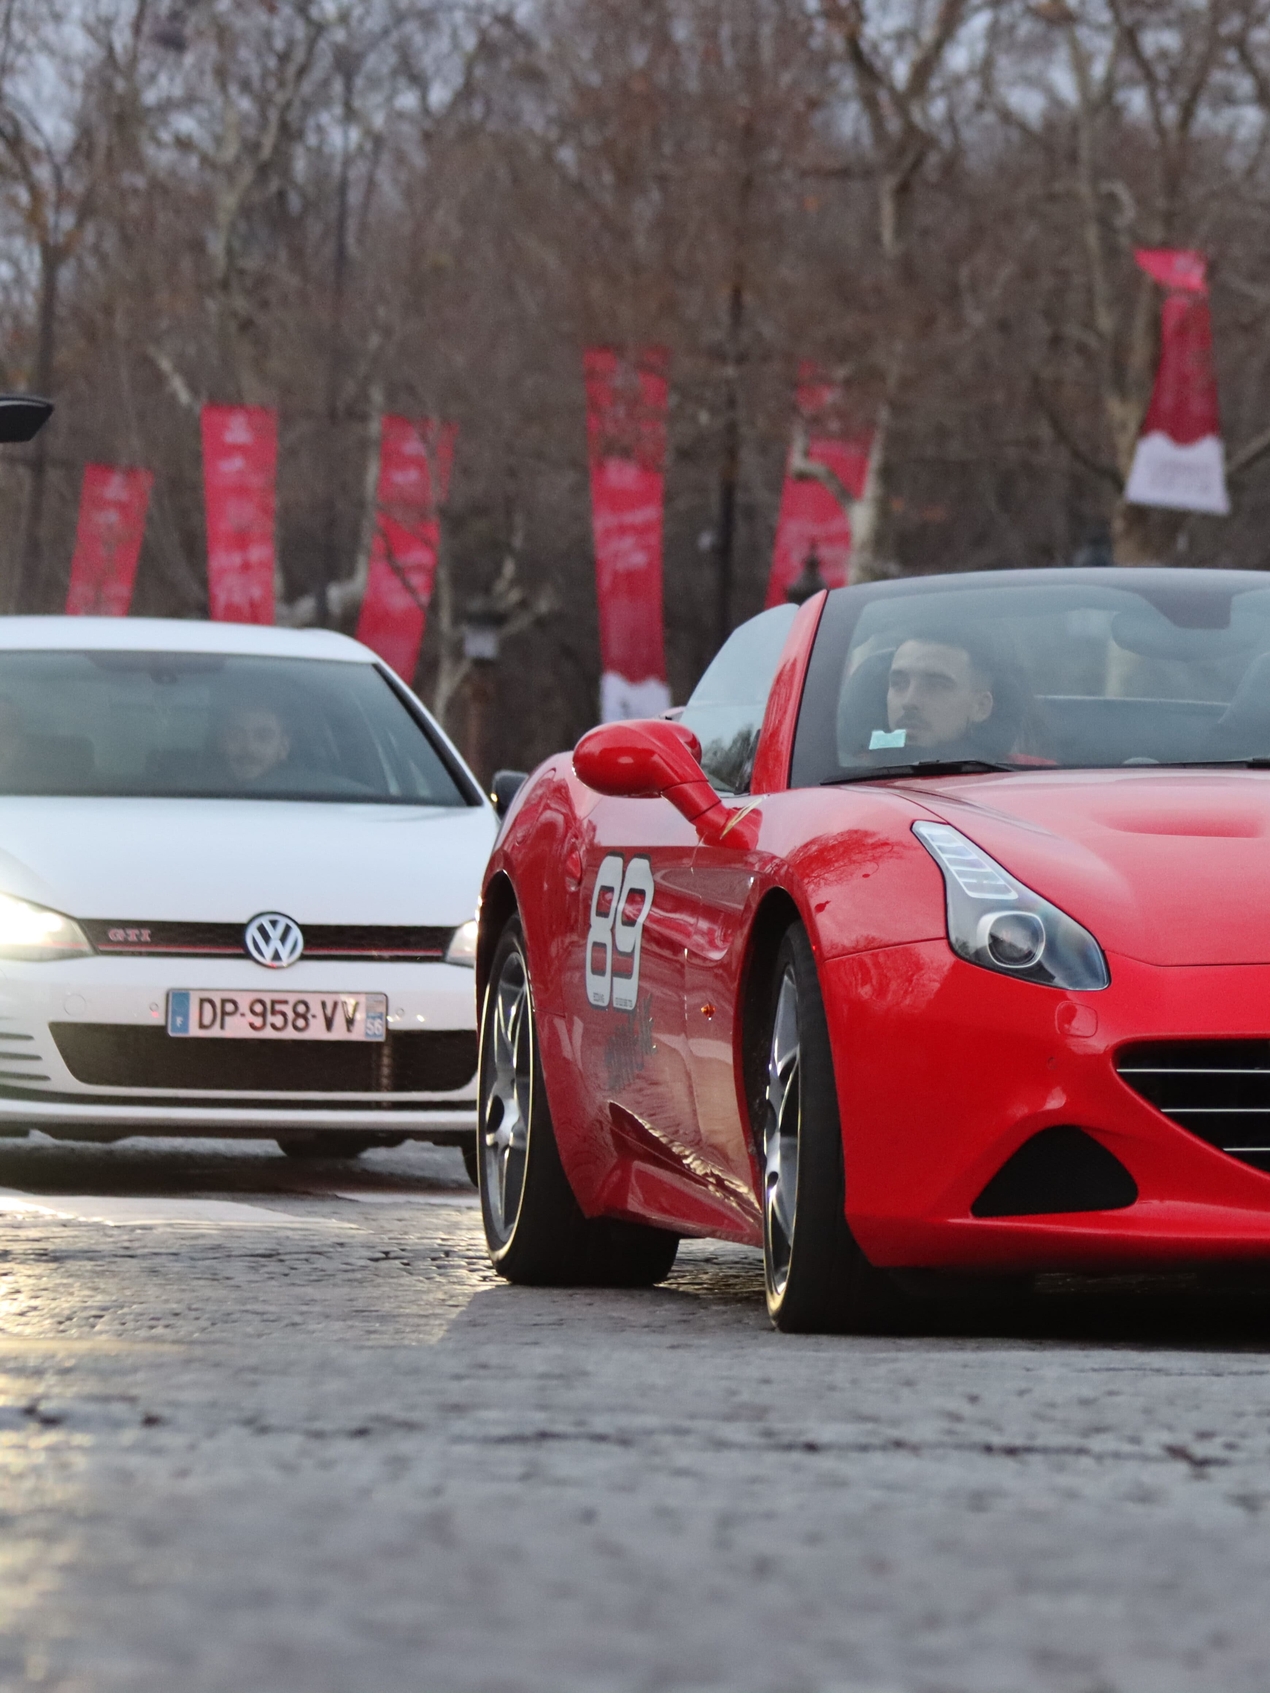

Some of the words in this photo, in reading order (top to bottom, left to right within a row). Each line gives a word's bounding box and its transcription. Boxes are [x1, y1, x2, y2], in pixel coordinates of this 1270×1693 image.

[108, 928, 151, 942] GTI
[584, 850, 654, 1012] 89
[175, 1016, 184, 1028] F
[197, 996, 360, 1033] DP-958-VV
[366, 1019, 384, 1036] 56
